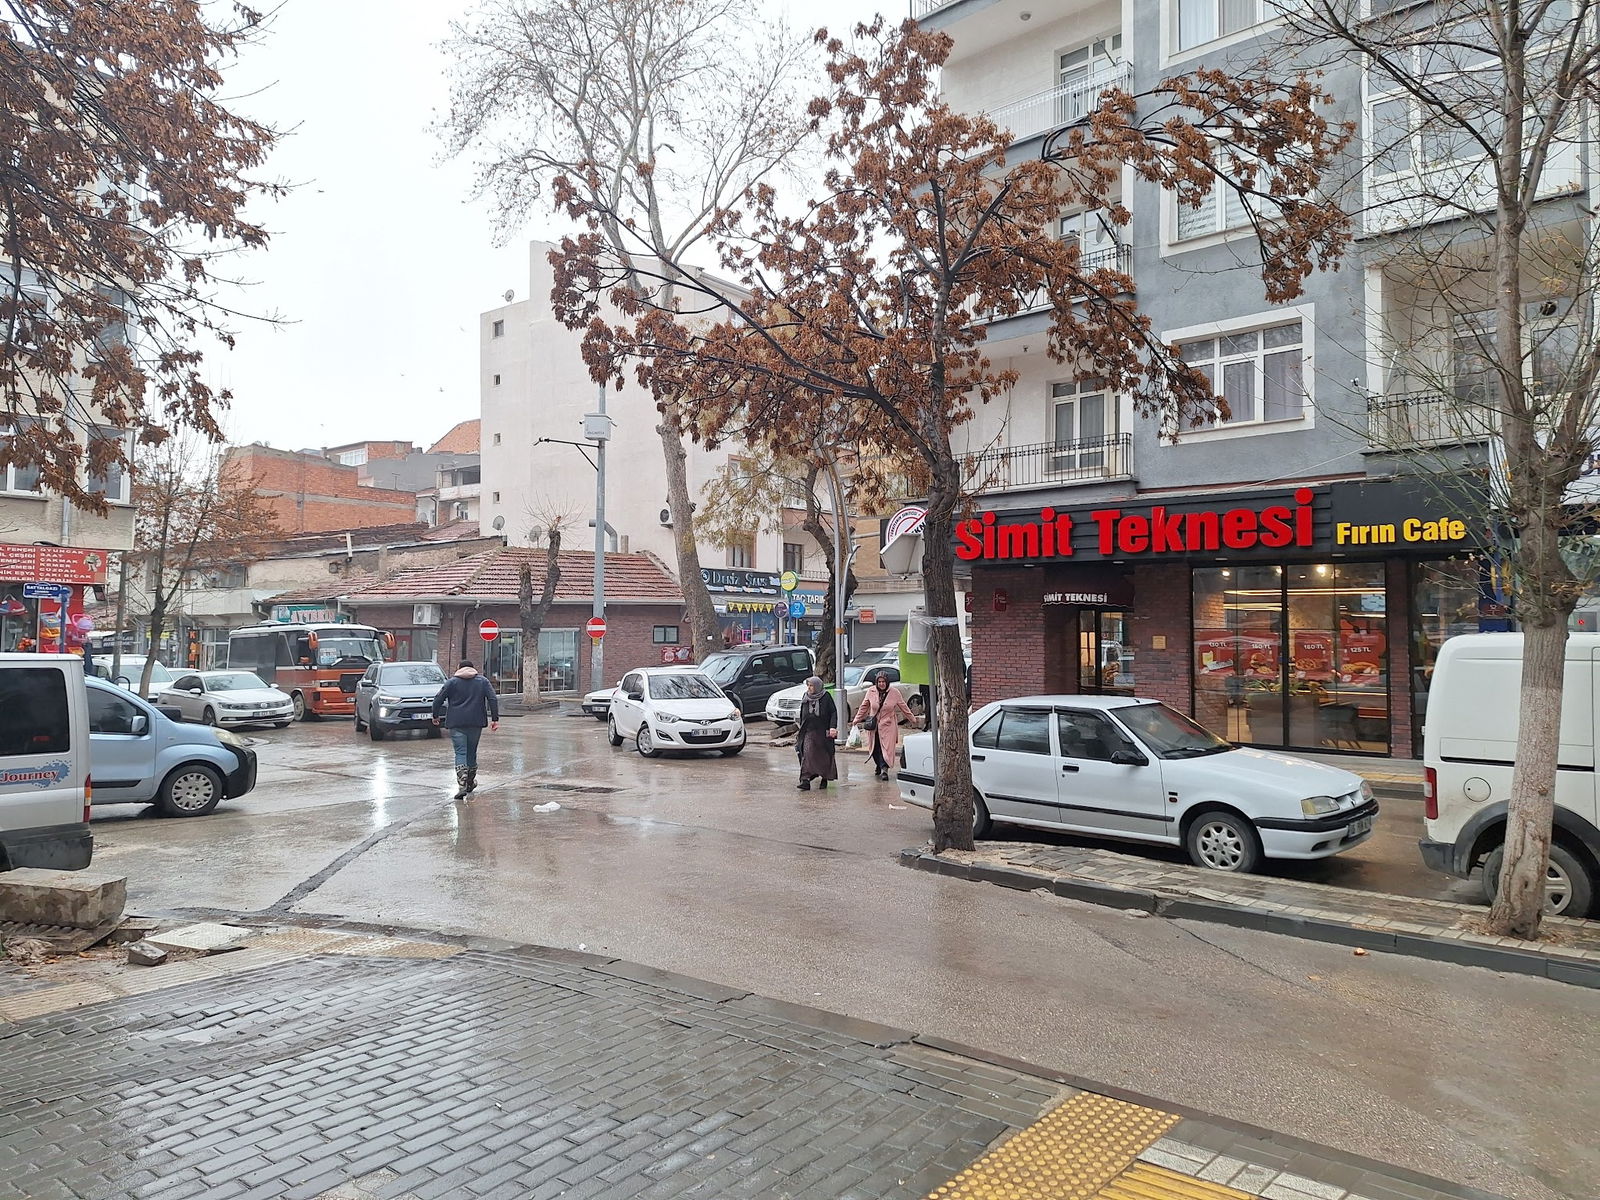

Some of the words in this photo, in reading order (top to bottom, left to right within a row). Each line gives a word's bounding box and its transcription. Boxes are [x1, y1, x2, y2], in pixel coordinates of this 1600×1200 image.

[953, 506, 1073, 560] Simit
[1091, 487, 1314, 554] Teknesi
[1336, 522, 1396, 545] Fırın
[1403, 517, 1467, 541] Cafe
[1065, 592, 1108, 603] TEKNESİ
[0, 770, 58, 783] Journey
